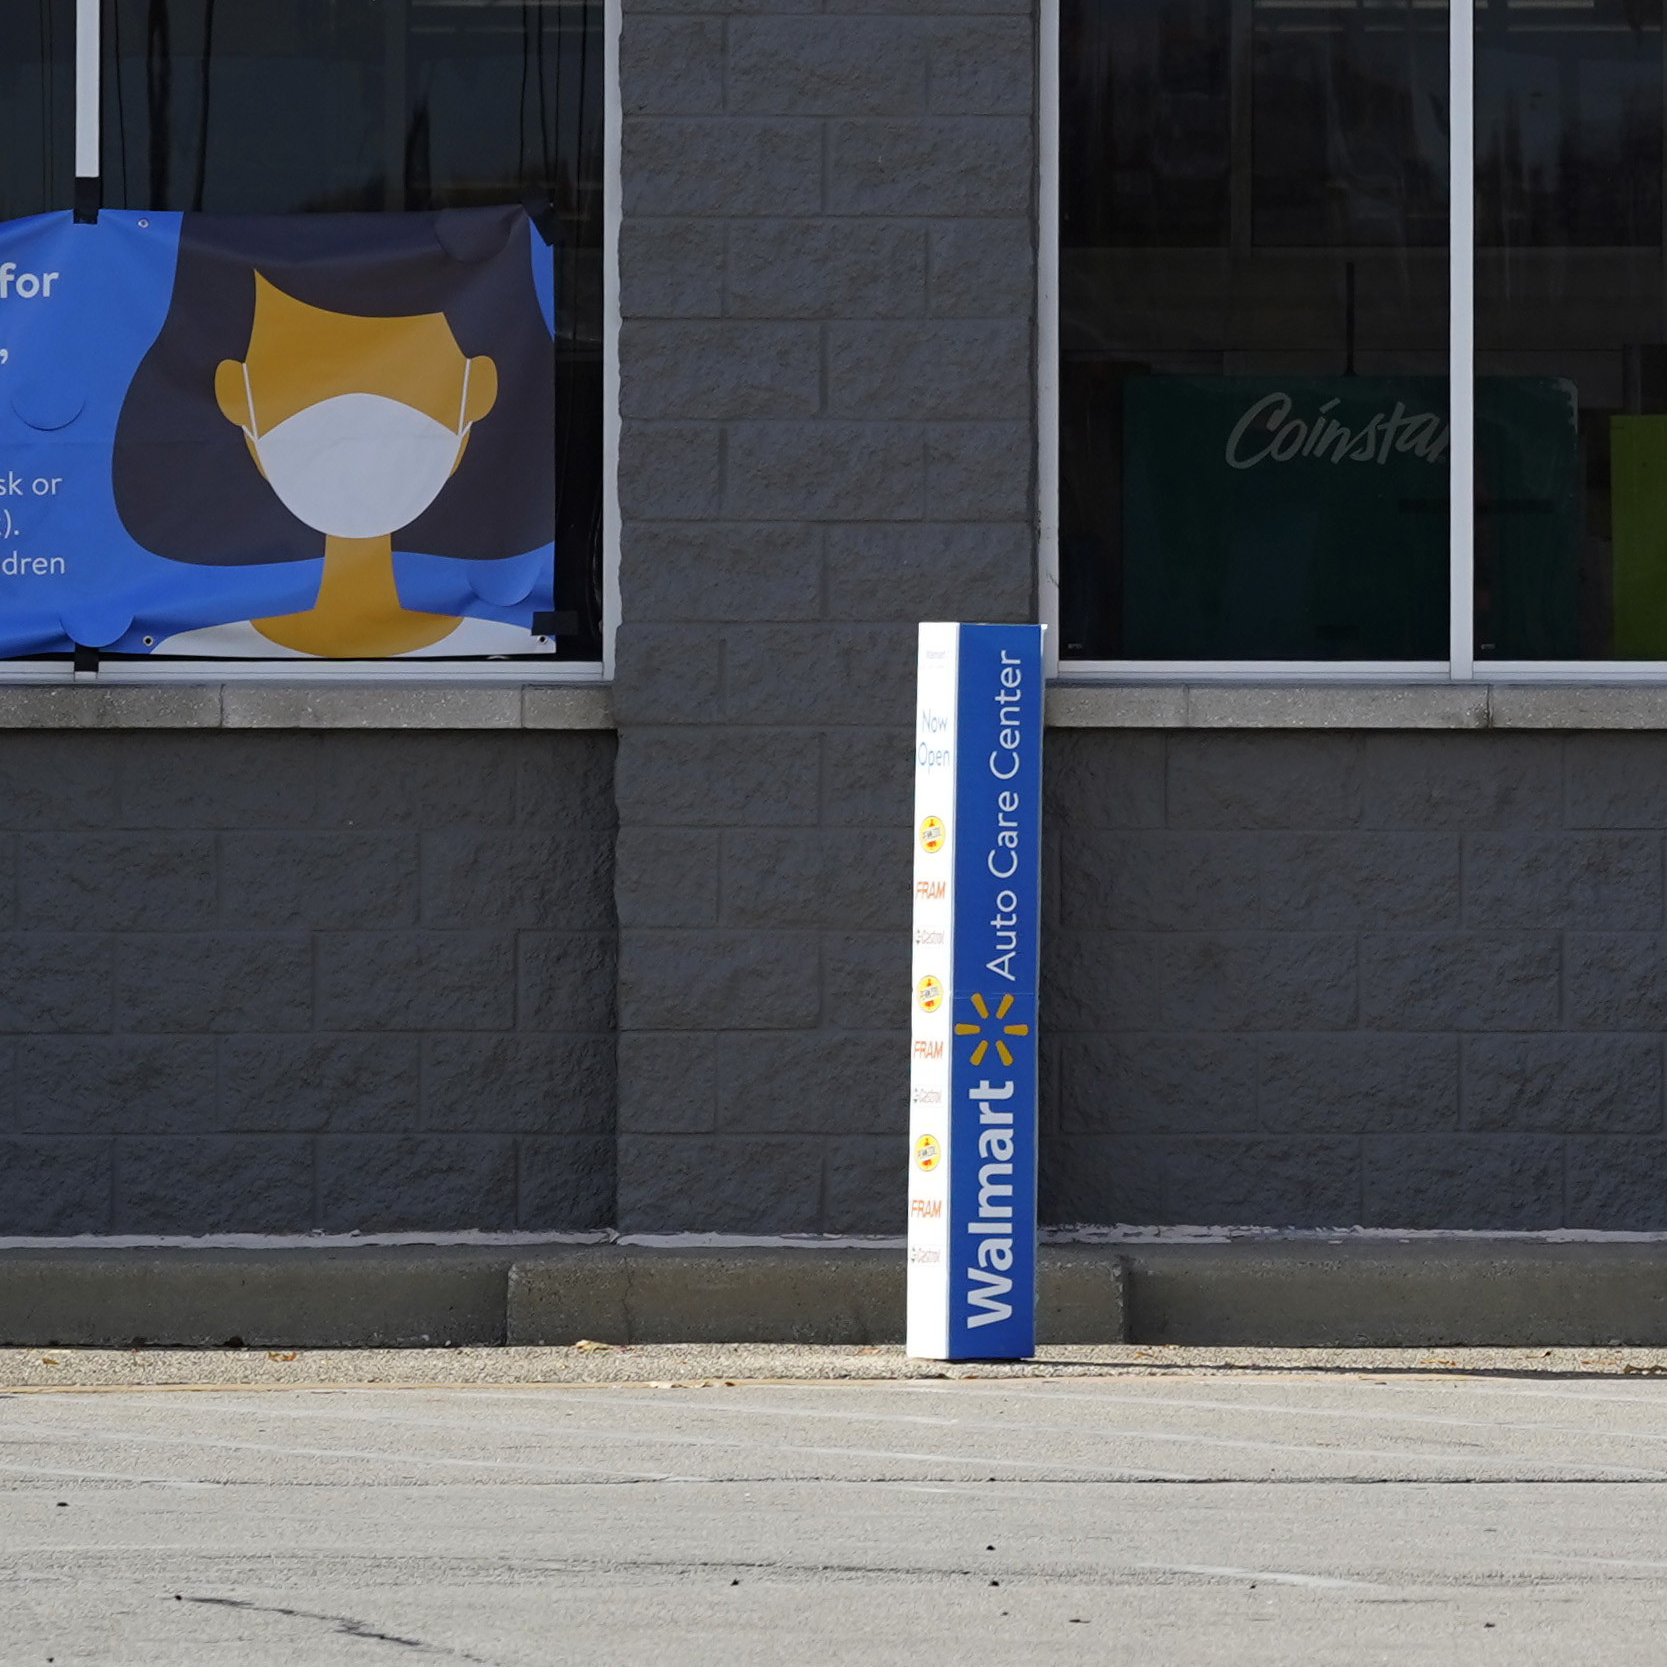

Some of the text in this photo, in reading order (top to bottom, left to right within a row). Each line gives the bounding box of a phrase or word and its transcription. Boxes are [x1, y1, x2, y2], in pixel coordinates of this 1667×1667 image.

[0, 262, 59, 299] for
[32, 477, 63, 496] or
[1, 550, 65, 575] dren
[922, 708, 948, 734] Now
[918, 741, 950, 775] Open
[986, 649, 1022, 981] Auto Care Center
[915, 880, 946, 901] FRAM
[913, 1040, 944, 1060] FRAM
[911, 1199, 942, 1219] FRAM
[967, 1080, 1014, 1329] Walmart
